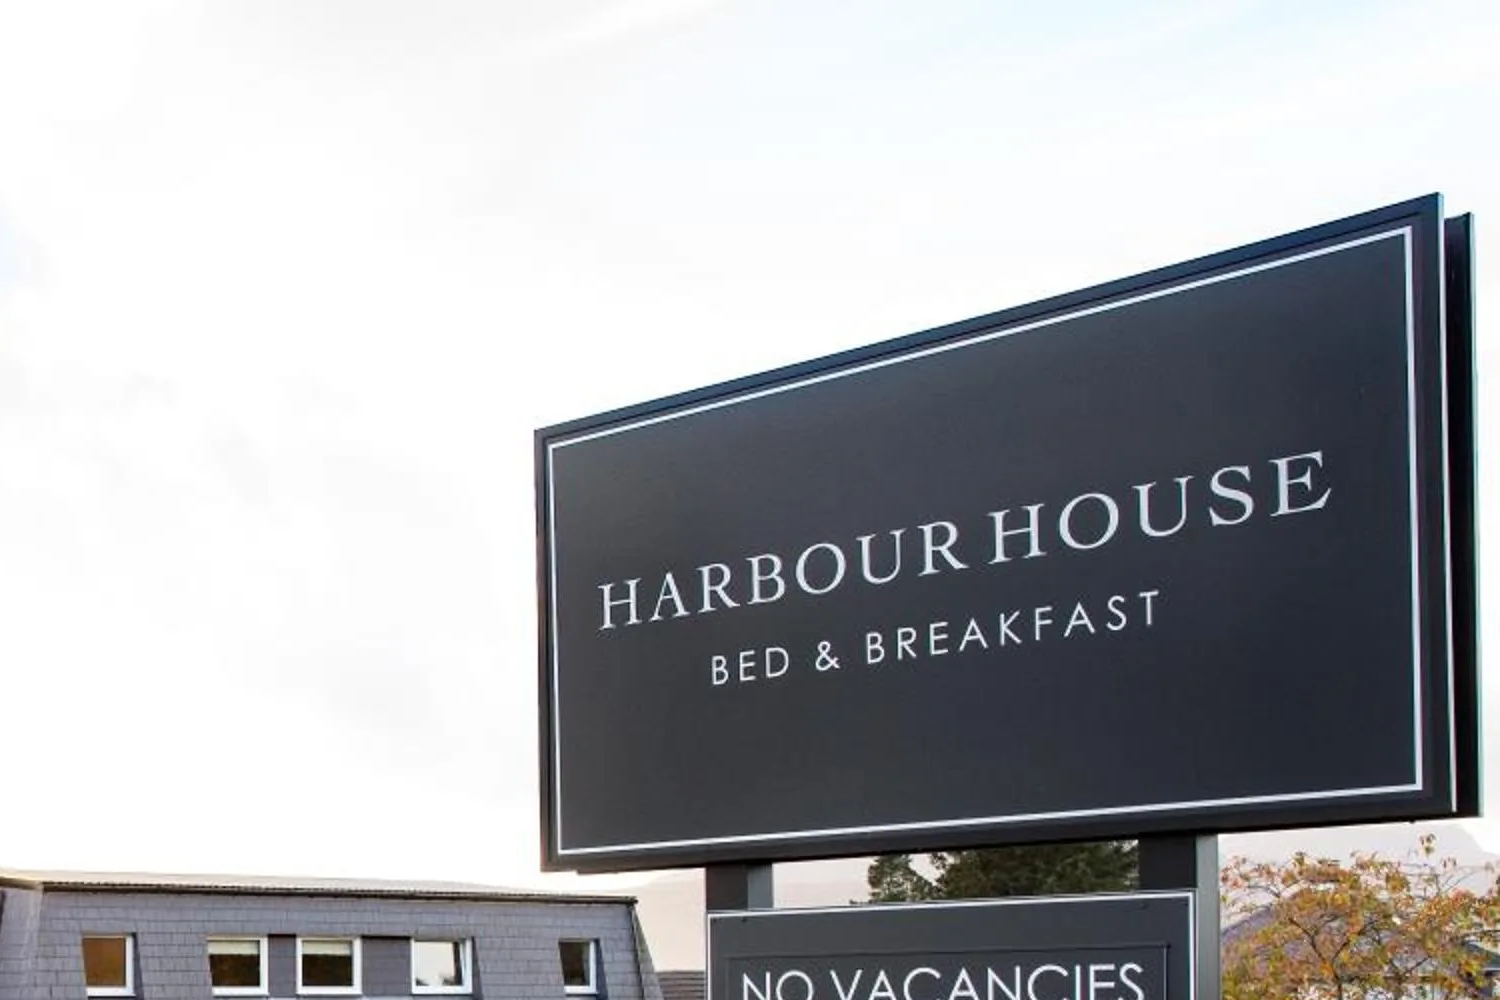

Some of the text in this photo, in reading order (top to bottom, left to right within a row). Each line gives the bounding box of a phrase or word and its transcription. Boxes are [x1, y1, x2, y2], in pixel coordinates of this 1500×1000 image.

[597, 450, 1332, 631] HARBOUR HOUSE
[711, 589, 1160, 686] BED & BREAKFAST
